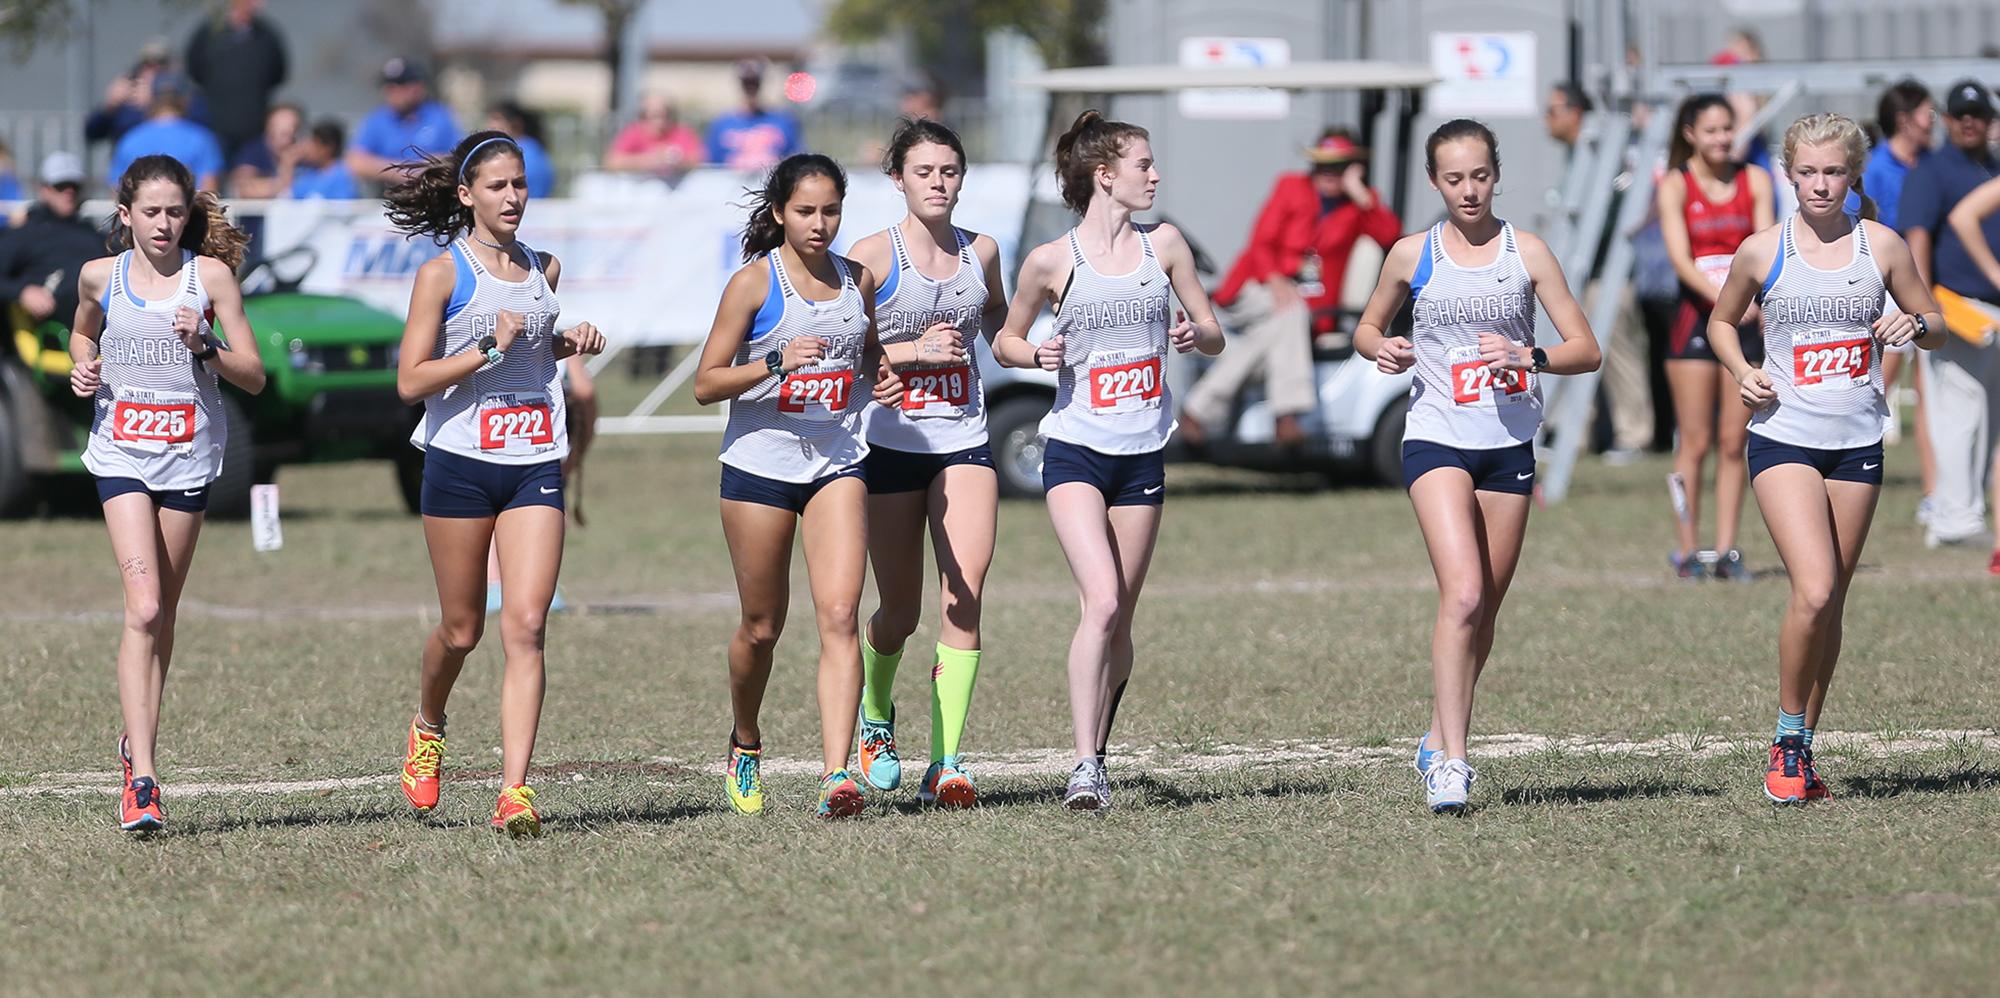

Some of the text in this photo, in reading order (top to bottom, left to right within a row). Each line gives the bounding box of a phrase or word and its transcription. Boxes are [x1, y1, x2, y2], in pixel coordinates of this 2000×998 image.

[1774, 296, 1881, 323] CHARGERS
[108, 338, 193, 365] CHARGE
[1107, 351, 1126, 360] STATE
[1802, 345, 1863, 377] 2224
[135, 391, 155, 399] STATE
[788, 377, 844, 405] 2221
[908, 372, 963, 403] 2219
[1098, 365, 1155, 401] 2220
[122, 407, 187, 438] 2225
[488, 409, 547, 442] 2222
